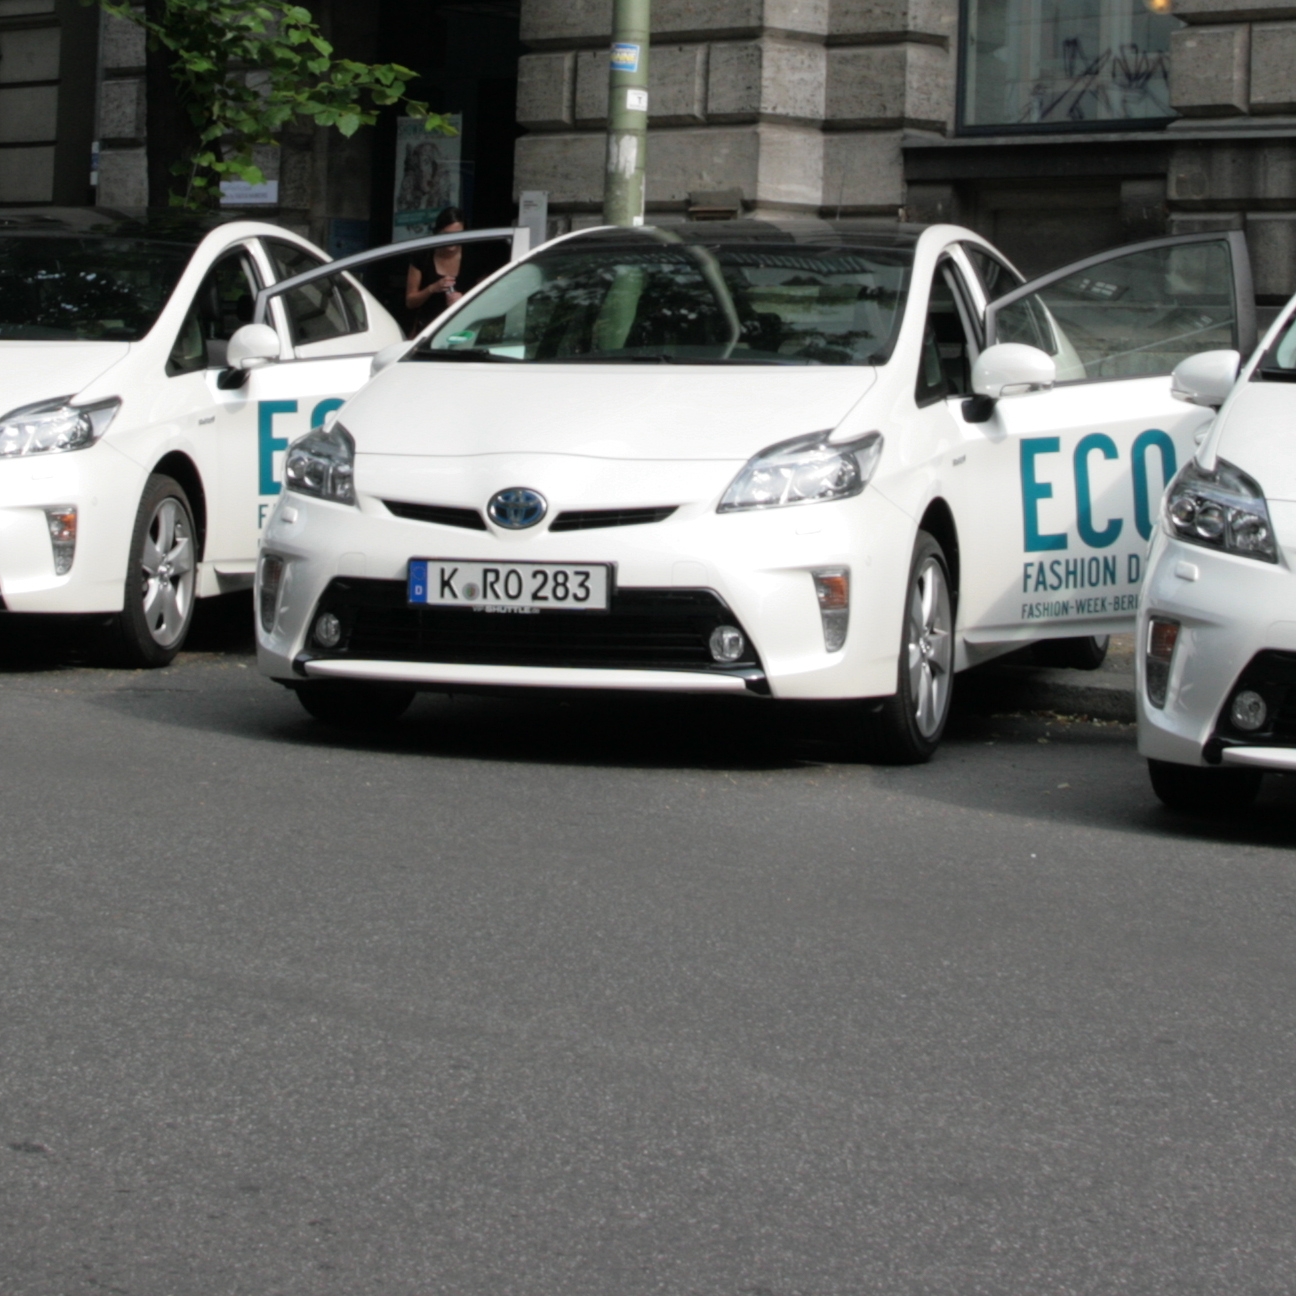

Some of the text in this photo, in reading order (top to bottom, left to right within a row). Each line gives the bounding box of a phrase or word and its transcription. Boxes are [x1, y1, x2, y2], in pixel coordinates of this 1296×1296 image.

[1019, 428, 1178, 553] ECO
[439, 566, 459, 599] K
[531, 569, 591, 602] 283
[1023, 555, 1117, 594] FASHION
